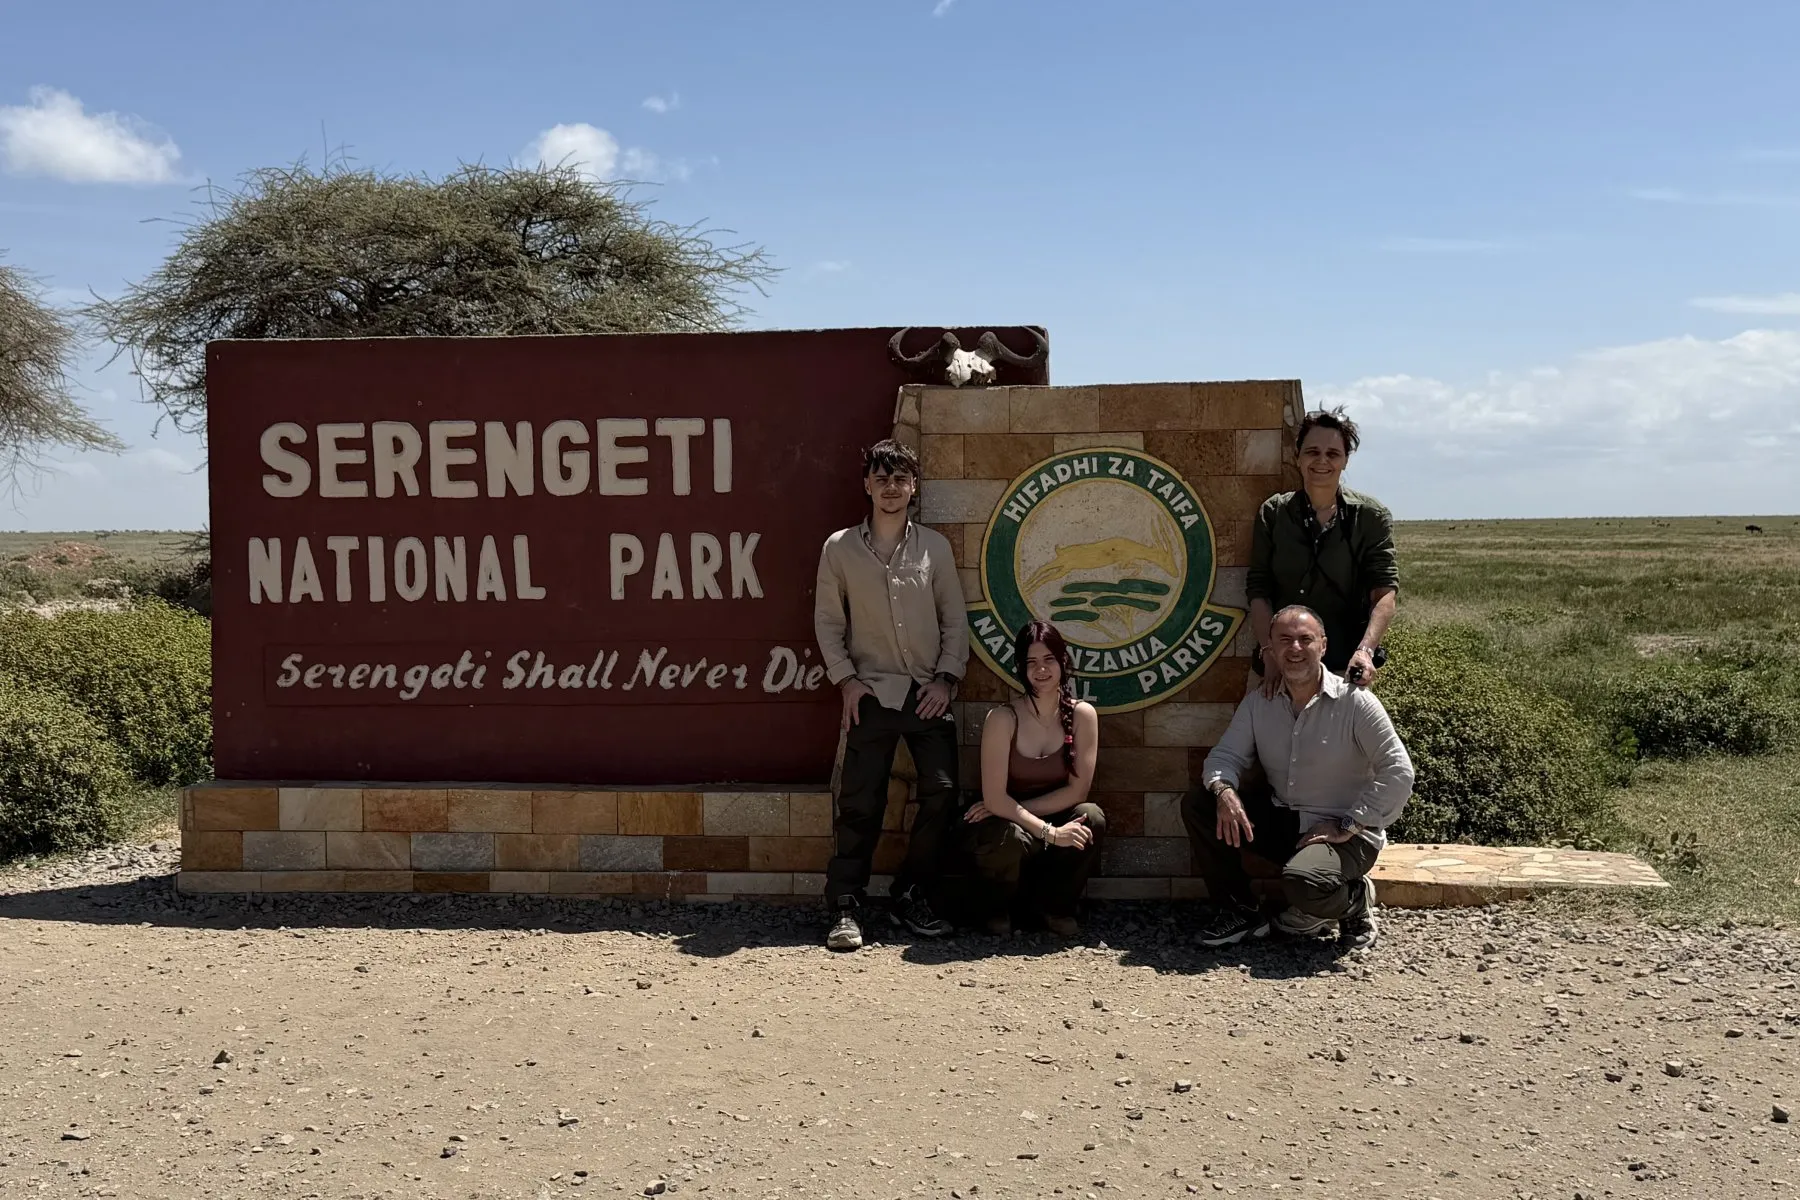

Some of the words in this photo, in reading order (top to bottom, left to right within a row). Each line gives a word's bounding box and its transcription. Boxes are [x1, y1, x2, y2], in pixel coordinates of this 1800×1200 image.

[259, 417, 733, 498] SERENGETI
[1003, 456, 1099, 523] HIFADHI
[1108, 456, 1136, 478] ZA
[1146, 469, 1200, 530] TAIFA
[248, 535, 546, 603] NATIONAL
[609, 532, 764, 600] PARK
[276, 650, 493, 700] Serengeti
[502, 649, 620, 690] Shall
[622, 646, 748, 691] Never
[762, 645, 825, 694] Die
[1066, 636, 1167, 672] NZANIA
[1137, 616, 1225, 693] PARKS
